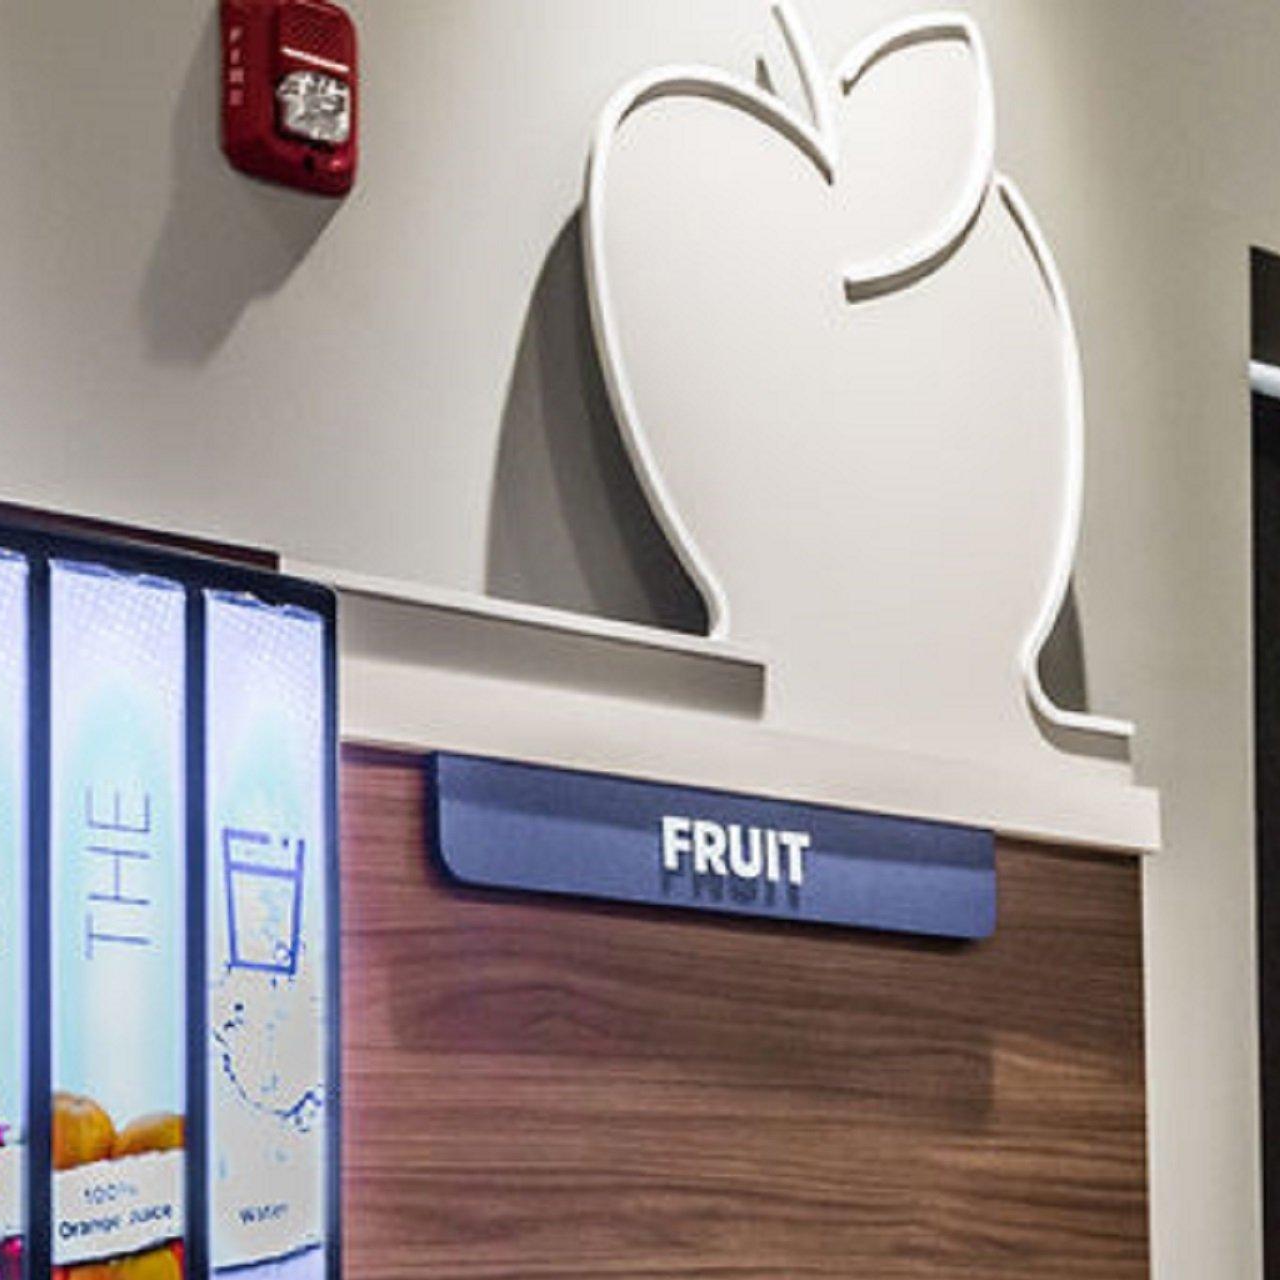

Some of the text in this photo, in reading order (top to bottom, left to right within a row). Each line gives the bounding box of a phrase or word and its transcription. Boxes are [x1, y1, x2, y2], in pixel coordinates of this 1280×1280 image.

[84, 787, 152, 960] THE
[661, 815, 811, 885] FRUIT
[129, 1203, 173, 1224] Juice
